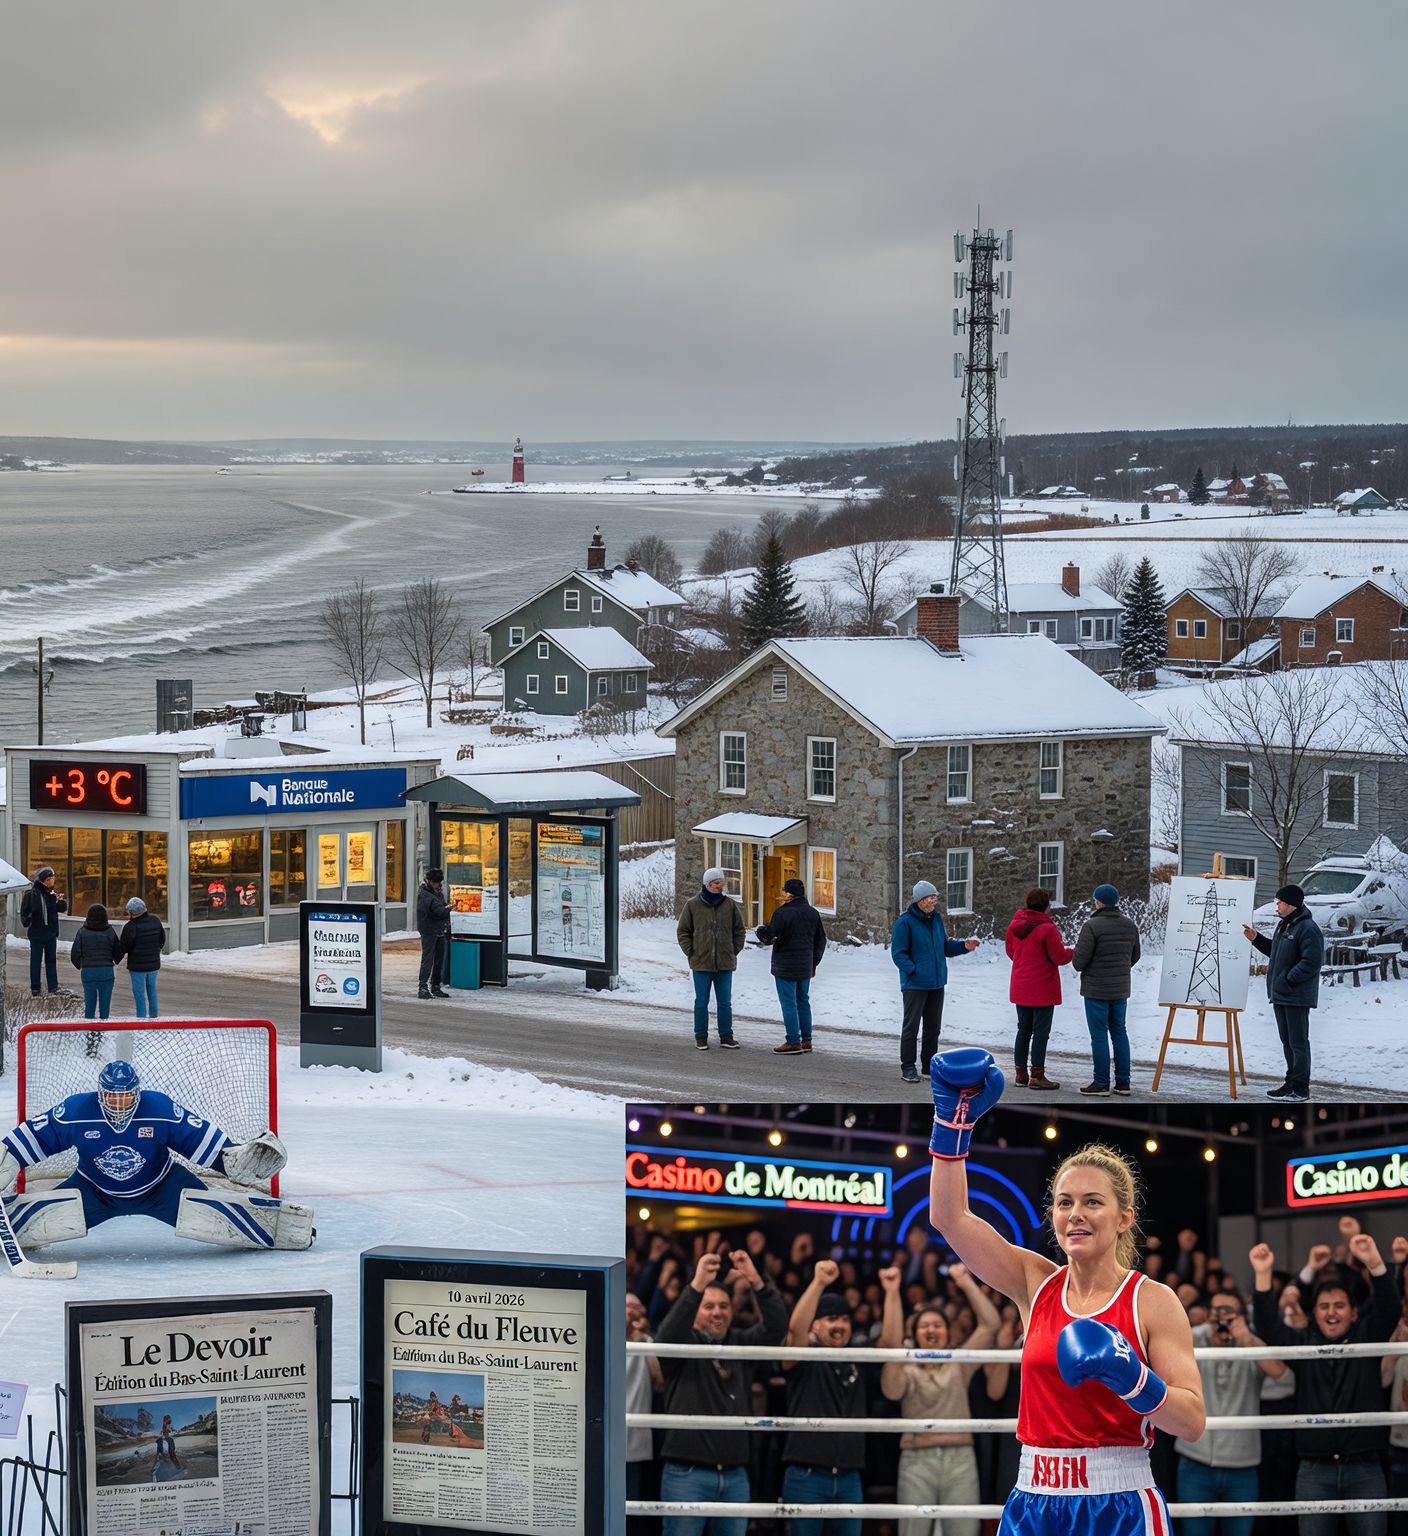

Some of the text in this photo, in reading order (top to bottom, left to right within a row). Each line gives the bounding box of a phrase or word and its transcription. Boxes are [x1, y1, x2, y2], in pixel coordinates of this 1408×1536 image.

[45, 769, 132, 805] +3 °C
[282, 778, 328, 792] Banque
[282, 788, 355, 806] Nationale
[625, 1151, 885, 1206] Casino de Montréal
[1293, 1160, 1380, 1198] Casino
[447, 1290, 525, 1307] 10 avril 2026
[394, 1310, 578, 1345] Café du Fleuve
[120, 1327, 273, 1367] Le Devoir
[438, 1350, 455, 1364] du
[458, 1351, 579, 1372] Bas-Saint-Laurent
[149, 1373, 167, 1388] du
[169, 1363, 307, 1387] Bas-Saint-Laurent
